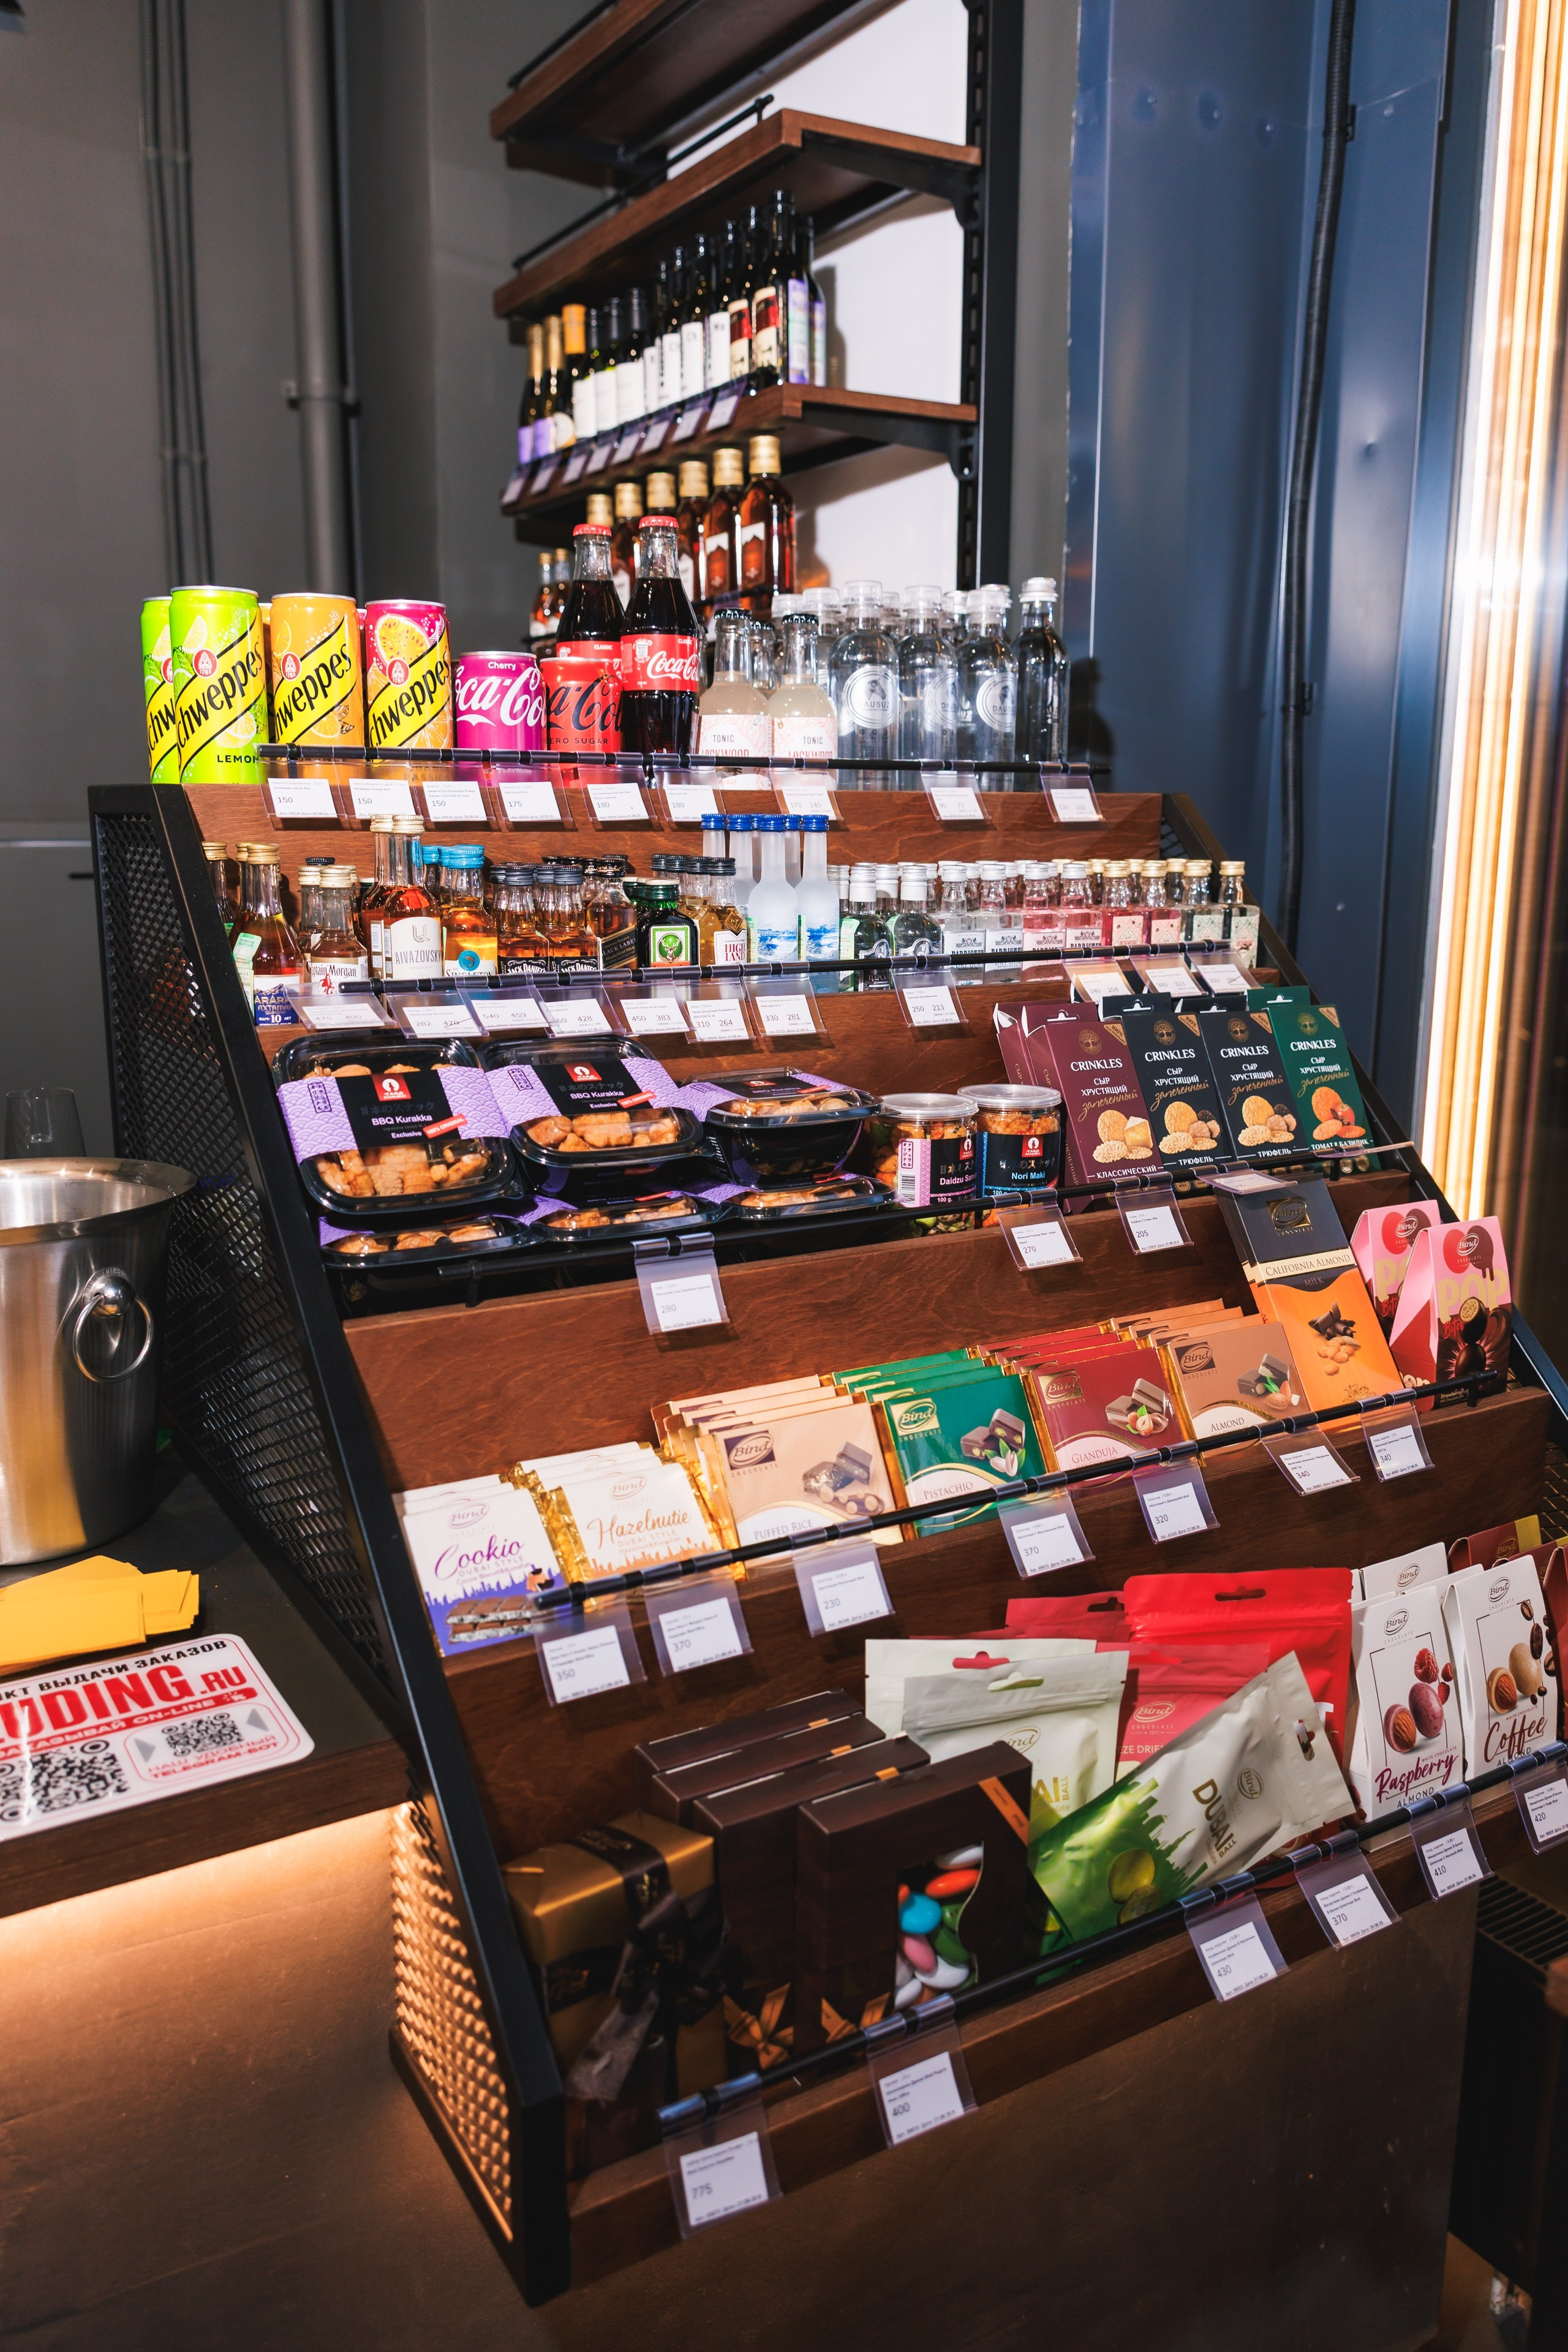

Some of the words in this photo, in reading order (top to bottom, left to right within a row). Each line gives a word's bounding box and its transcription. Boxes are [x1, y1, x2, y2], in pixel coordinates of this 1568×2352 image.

[488, 661, 516, 671] Cherry
[275, 643, 352, 741] hweppes
[176, 641, 262, 760] chweppes
[369, 650, 450, 748] chweppes
[712, 734, 734, 743] TONIC
[803, 736, 823, 745] TONIC
[725, 943, 745, 952] HIGH
[395, 949, 440, 965] AIVAZOVSKY
[725, 952, 745, 961] LAND
[329, 965, 356, 978] Morgan
[507, 965, 523, 974] JACK
[561, 965, 577, 973] JACK
[271, 1014, 281, 1023] 10
[1220, 1045, 1269, 1058] CRINKLES
[1290, 1039, 1336, 1052] CRINKLES
[1145, 1049, 1196, 1061] CRINKLES
[1070, 1058, 1123, 1071] CRINKLES
[1242, 1063, 1258, 1071] СЫР
[1299, 1063, 1341, 1074] ХРУСТЯЩИЙ
[1166, 1067, 1183, 1076] СЫР
[1230, 1070, 1274, 1082] ХРУСТЯЩИЙ
[1154, 1074, 1199, 1087] ХРУСТЯЩИЙ
[1297, 1068, 1350, 1098] запеченный
[1080, 1084, 1128, 1096] ХРУСТЯЩИЙ
[1150, 1079, 1209, 1112] запеченный
[1227, 1075, 1283, 1106] запеченный
[1078, 1090, 1138, 1122] запеченный
[371, 1117, 394, 1126] BBQ
[396, 1114, 432, 1123] Kurakka
[1311, 1142, 1333, 1150] ТОМАТ
[1257, 1148, 1292, 1158] ТРЮФЕЛЬ
[1178, 1156, 1213, 1166] ТРЮФЕЛЬ
[1096, 1165, 1157, 1179] КЛАССИЧЕСКИЙ
[940, 1175, 964, 1186] Daidzu
[1397, 1221, 1417, 1231] Bind
[1023, 1245, 1036, 1254] 270
[1458, 1237, 1477, 1249] Bind
[1265, 1261, 1315, 1276] CALIFORNIA
[1316, 1254, 1351, 1267] ALMOND
[1304, 1276, 1324, 1286] MILK
[1437, 1268, 1509, 1324] POP
[660, 1304, 677, 1313] 280
[1443, 1318, 1464, 1340] Bites
[1183, 1351, 1210, 1363] Bind
[1183, 1369, 1218, 1381] CHOCOLATE
[1047, 1398, 1086, 1411] CHOCOLATE
[900, 1408, 933, 1423] Bind
[1210, 1417, 1245, 1432] ALMOND
[899, 1428, 942, 1443] CHOCOLATE
[734, 1440, 771, 1457] Bind
[1071, 1446, 1118, 1464] GIANDUJA
[1379, 1453, 1392, 1463] 340
[731, 1463, 778, 1478] CHOCOLATE
[1296, 1470, 1310, 1479] 340
[924, 1481, 973, 1500] PISTACHIO
[1155, 1514, 1169, 1524] 320
[586, 1509, 691, 1549] Hazelnutie
[753, 1525, 789, 1540] PUFFED
[791, 1519, 813, 1531] RICE
[617, 1536, 646, 1548] DUBAI
[650, 1529, 677, 1542] STYLE
[1023, 1546, 1039, 1556] 370
[458, 1564, 489, 1577] DUBAI
[495, 1555, 524, 1568] STYLE
[1399, 1569, 1419, 1581] Bind
[1490, 1582, 1509, 1596] Bind
[823, 1597, 841, 1610] 230
[1488, 1598, 1515, 1611] CHOCOLATE
[1385, 1615, 1408, 1629] Bind
[1384, 1630, 1414, 1645] CHOCOLATE
[672, 1639, 692, 1653] 370
[38, 1663, 129, 1692] ВЫДАЧИ
[134, 1640, 228, 1669] ЗАКАЗОВ
[556, 1668, 576, 1682] 350
[132, 1698, 216, 1725] ON-LINE
[1137, 1703, 1170, 1714] Bind
[1517, 1705, 1538, 1716] CHOCOLATE
[1484, 1714, 1548, 1763] Coffee
[191, 1735, 277, 1763] УДОБНЫЙ
[1434, 1746, 1457, 1758] CHOCOLATE
[150, 1741, 281, 1780] TELEGRAM-БОТ
[1243, 1770, 1259, 1798] Bind
[1374, 1754, 1459, 1804] Raspberry
[1397, 1787, 1434, 1808] ALMOND
[1192, 1778, 1234, 1852] DUBAI
[1534, 1812, 1546, 1822] 420
[1218, 1839, 1237, 1858] BALL
[1434, 1865, 1447, 1876] 410
[1332, 1913, 1348, 1925] 370
[1217, 1964, 1232, 1977] 430
[891, 2101, 911, 2118] 400
[690, 2182, 713, 2199] 775
